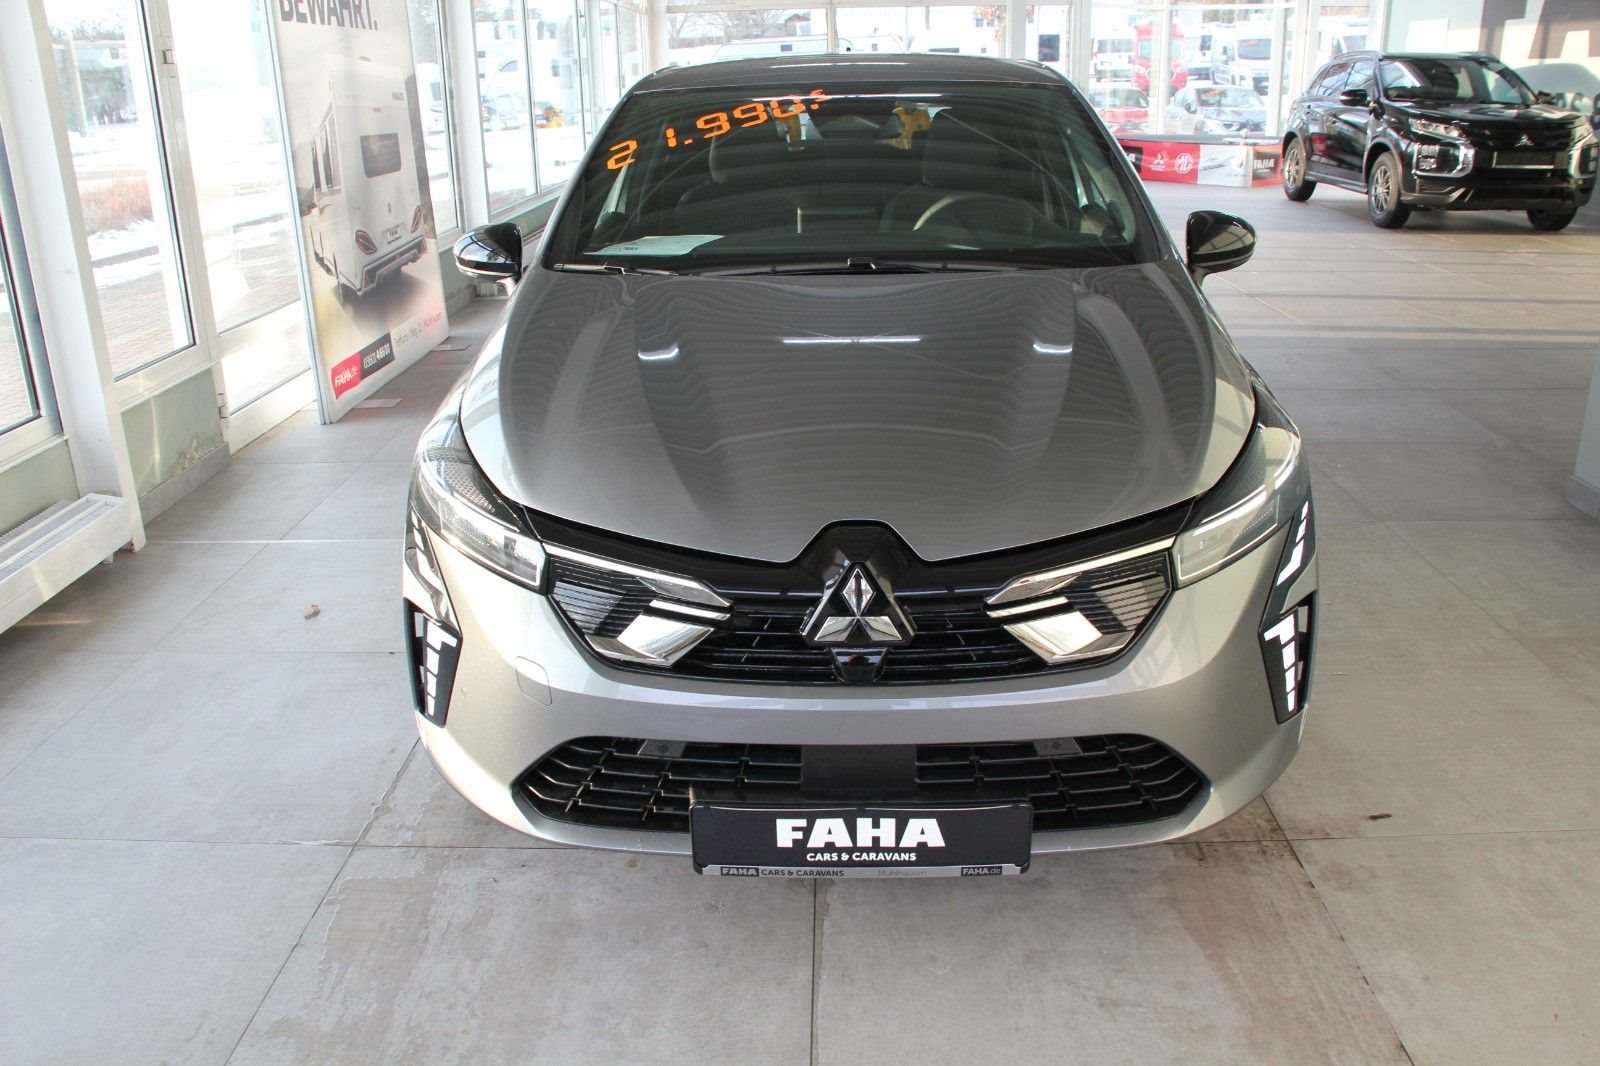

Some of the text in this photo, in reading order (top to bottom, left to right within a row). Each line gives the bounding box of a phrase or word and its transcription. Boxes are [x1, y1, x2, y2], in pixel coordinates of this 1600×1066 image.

[775, 817, 946, 848] FAHA
[806, 851, 917, 862] CARS & CARAVANS
[722, 867, 758, 876] FAHA
[796, 869, 845, 877] CARAVANS
